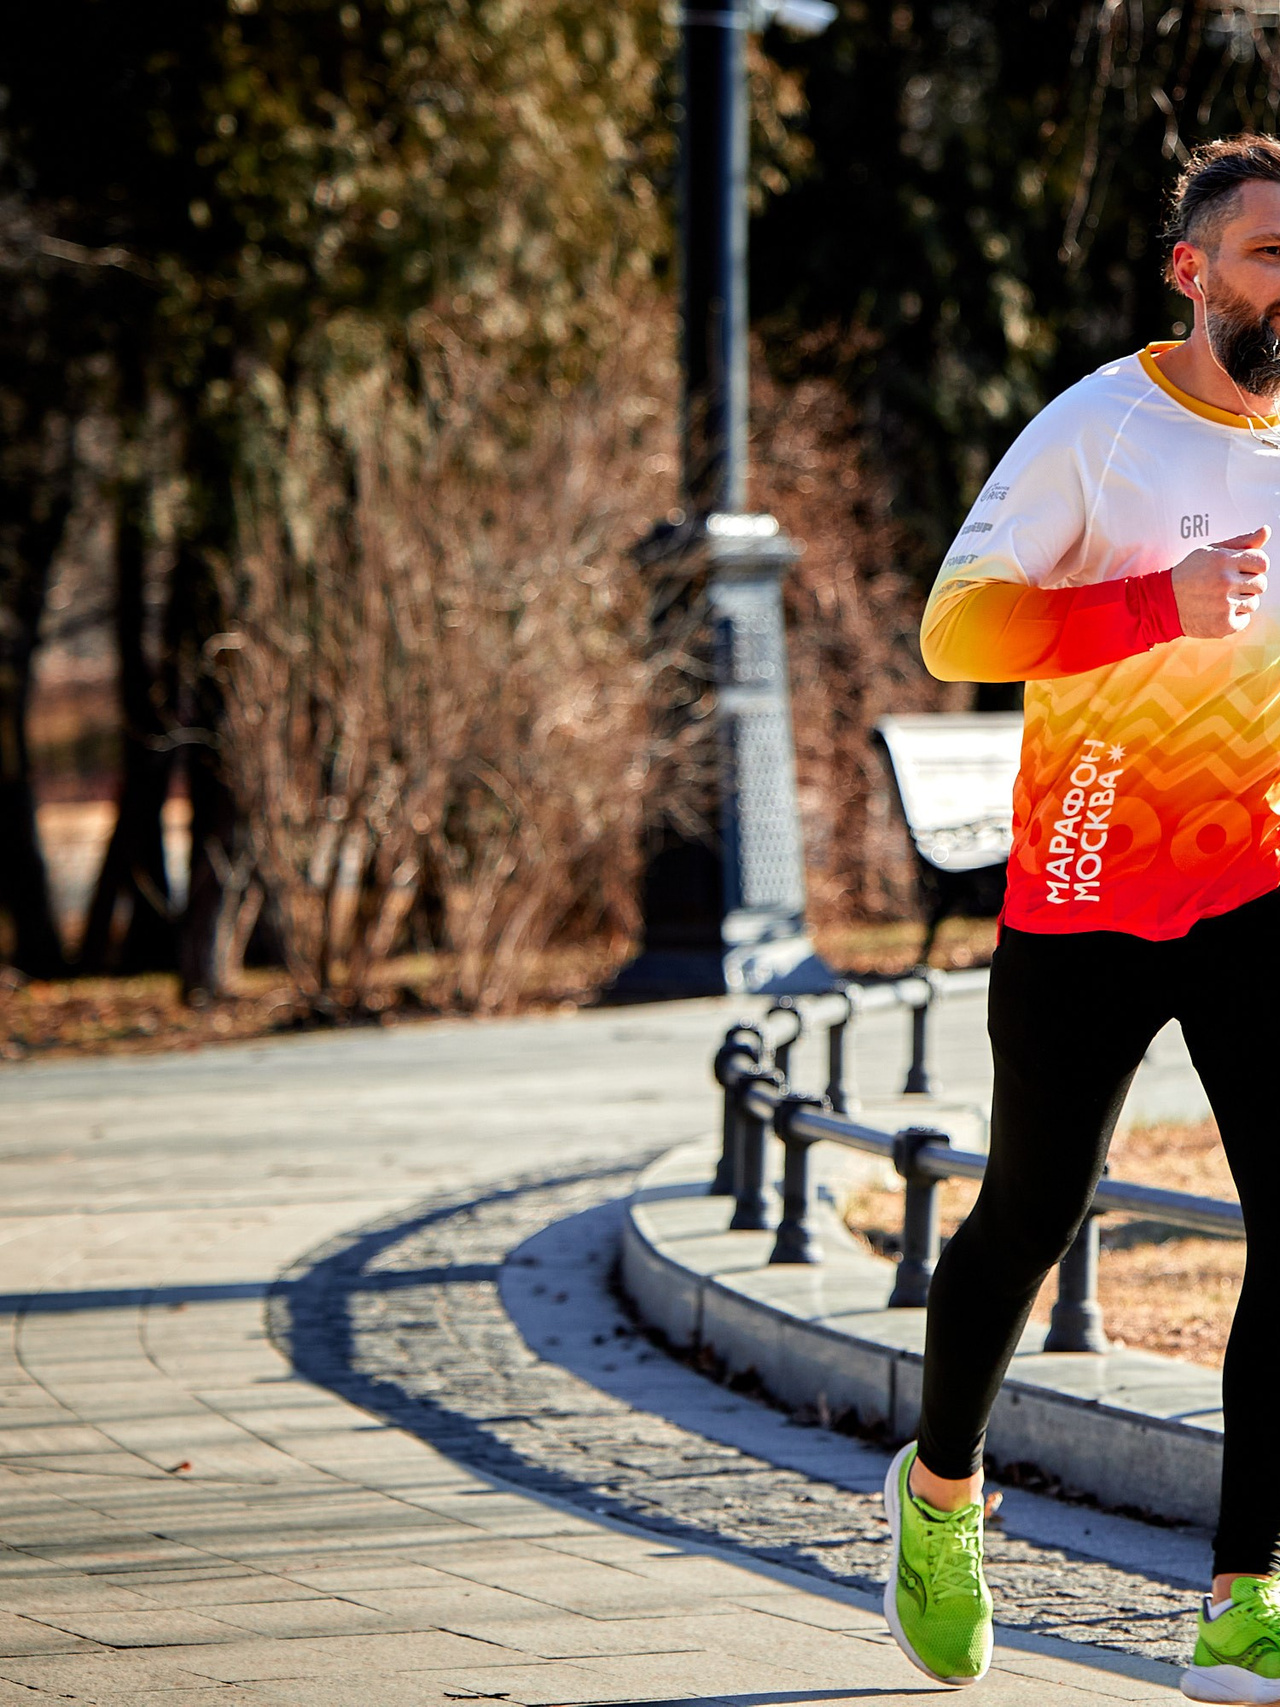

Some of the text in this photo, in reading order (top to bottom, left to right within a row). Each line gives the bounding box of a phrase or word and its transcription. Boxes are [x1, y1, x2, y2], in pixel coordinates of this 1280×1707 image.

[1180, 513, 1209, 539] GRi
[1046, 739, 1105, 904] МАРАФОН
[1074, 768, 1124, 902] МОСКВА
